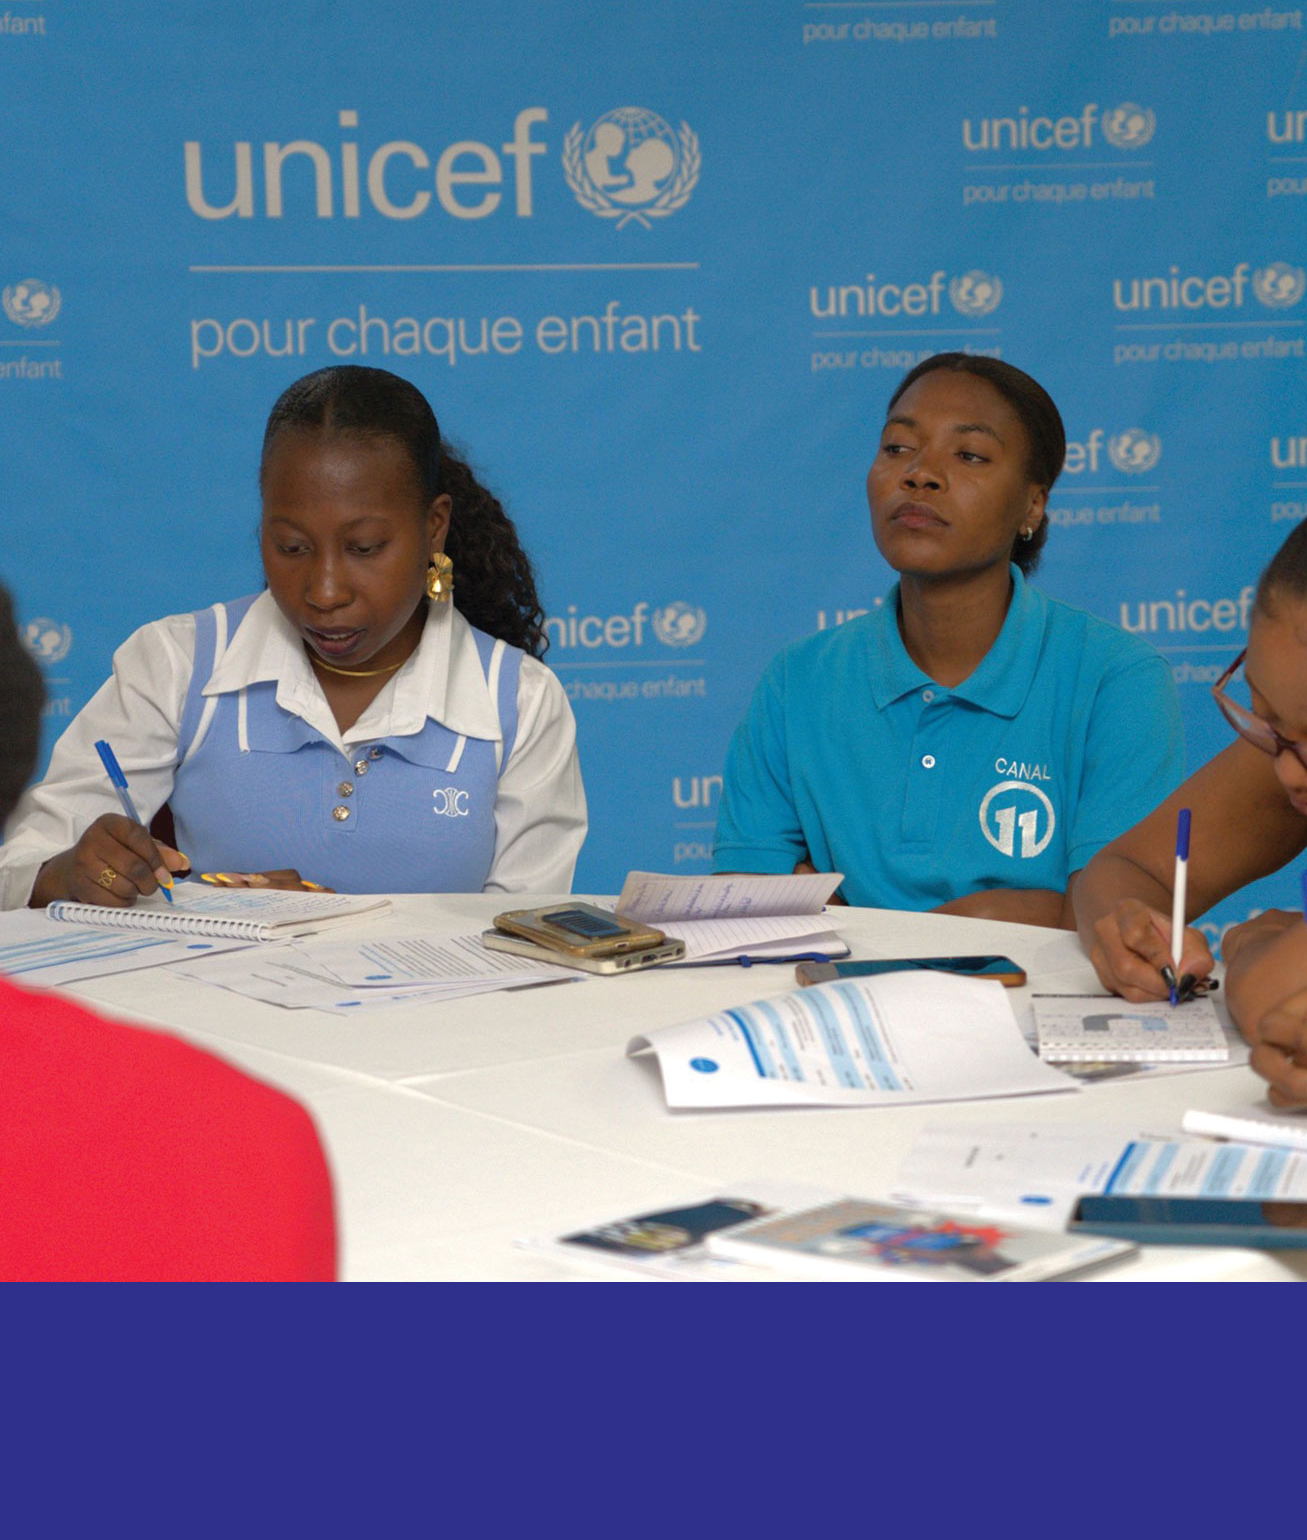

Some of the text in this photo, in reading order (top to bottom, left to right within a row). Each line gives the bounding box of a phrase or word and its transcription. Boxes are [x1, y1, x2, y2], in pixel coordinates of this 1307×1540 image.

[0, 11, 46, 35] fant
[803, 16, 997, 45] pour chaque enfant
[1109, 7, 1303, 39] pour chaque enfant
[963, 103, 1098, 152] unicef
[184, 107, 549, 220] unicef
[963, 177, 1156, 206] pour chaque enfant
[810, 271, 946, 319] unicef
[1113, 263, 1249, 311] unicef
[191, 301, 701, 369] pour chaque enfant
[1114, 335, 1305, 366] pour chaque enfant
[811, 351, 857, 372] pour
[543, 602, 649, 648] nicef
[1120, 586, 1254, 633] unicef
[641, 675, 706, 699] enfant
[995, 757, 1051, 780] CANAL
